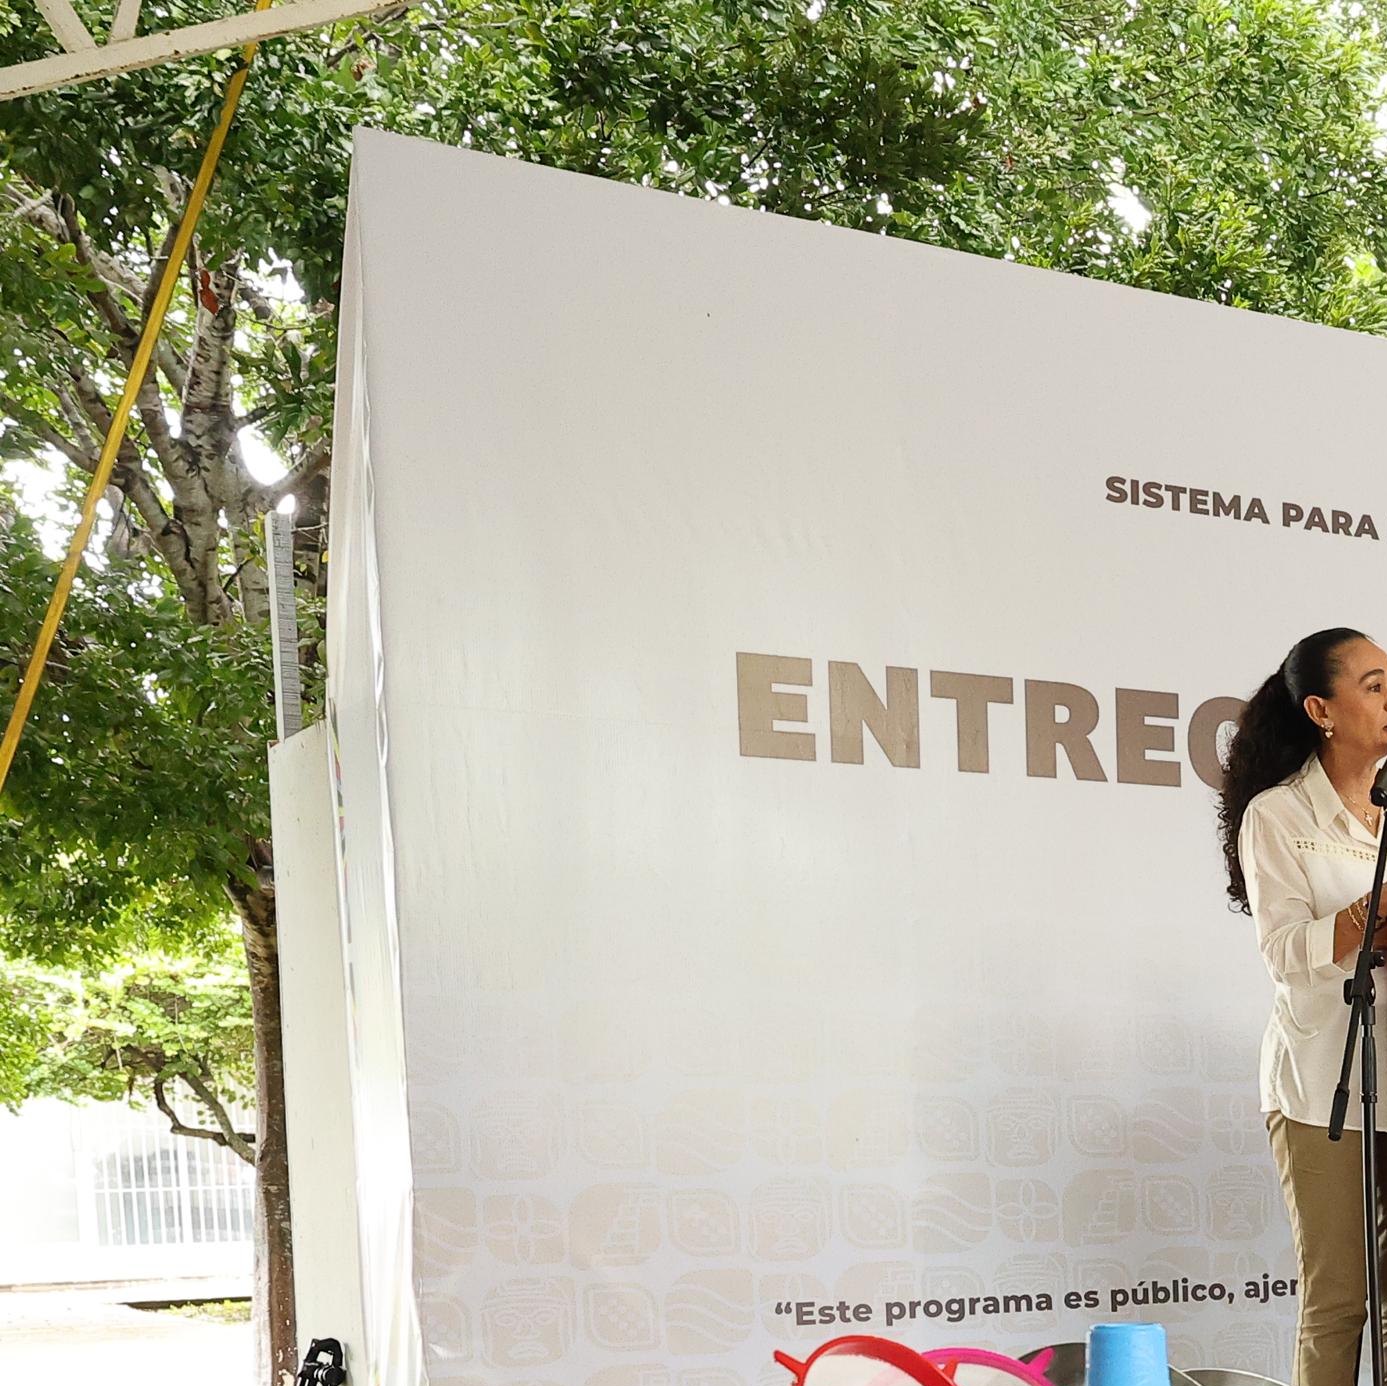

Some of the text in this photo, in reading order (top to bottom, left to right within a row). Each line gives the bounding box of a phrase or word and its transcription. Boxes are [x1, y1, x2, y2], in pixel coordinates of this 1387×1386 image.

[1105, 475, 1270, 525] SISTEMA
[1282, 501, 1380, 540] PARA
[885, 1293, 1054, 1326] programa
[1064, 1290, 1100, 1310] es
[1110, 1276, 1235, 1313] público,
